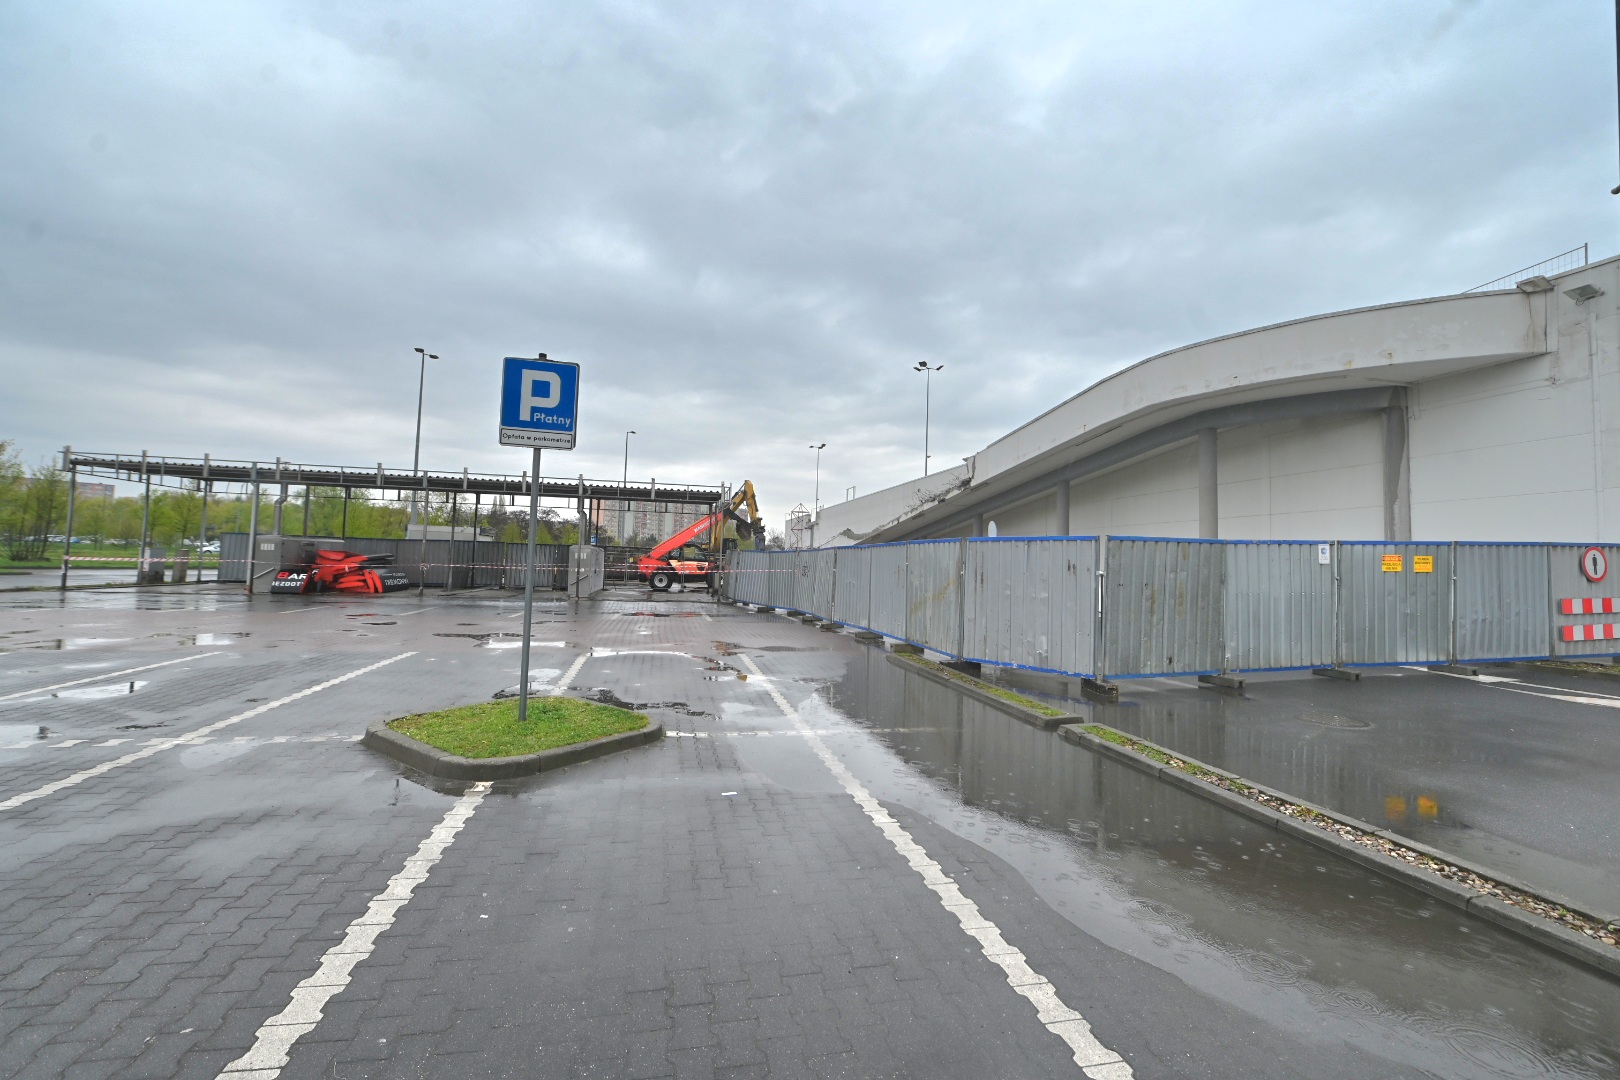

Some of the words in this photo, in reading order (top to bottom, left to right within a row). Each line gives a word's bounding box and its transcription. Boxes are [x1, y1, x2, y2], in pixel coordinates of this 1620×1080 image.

[520, 369, 561, 421] P
[533, 412, 571, 427] Płatny
[502, 432, 525, 440] Opłata
[533, 436, 571, 444] parkometrze
